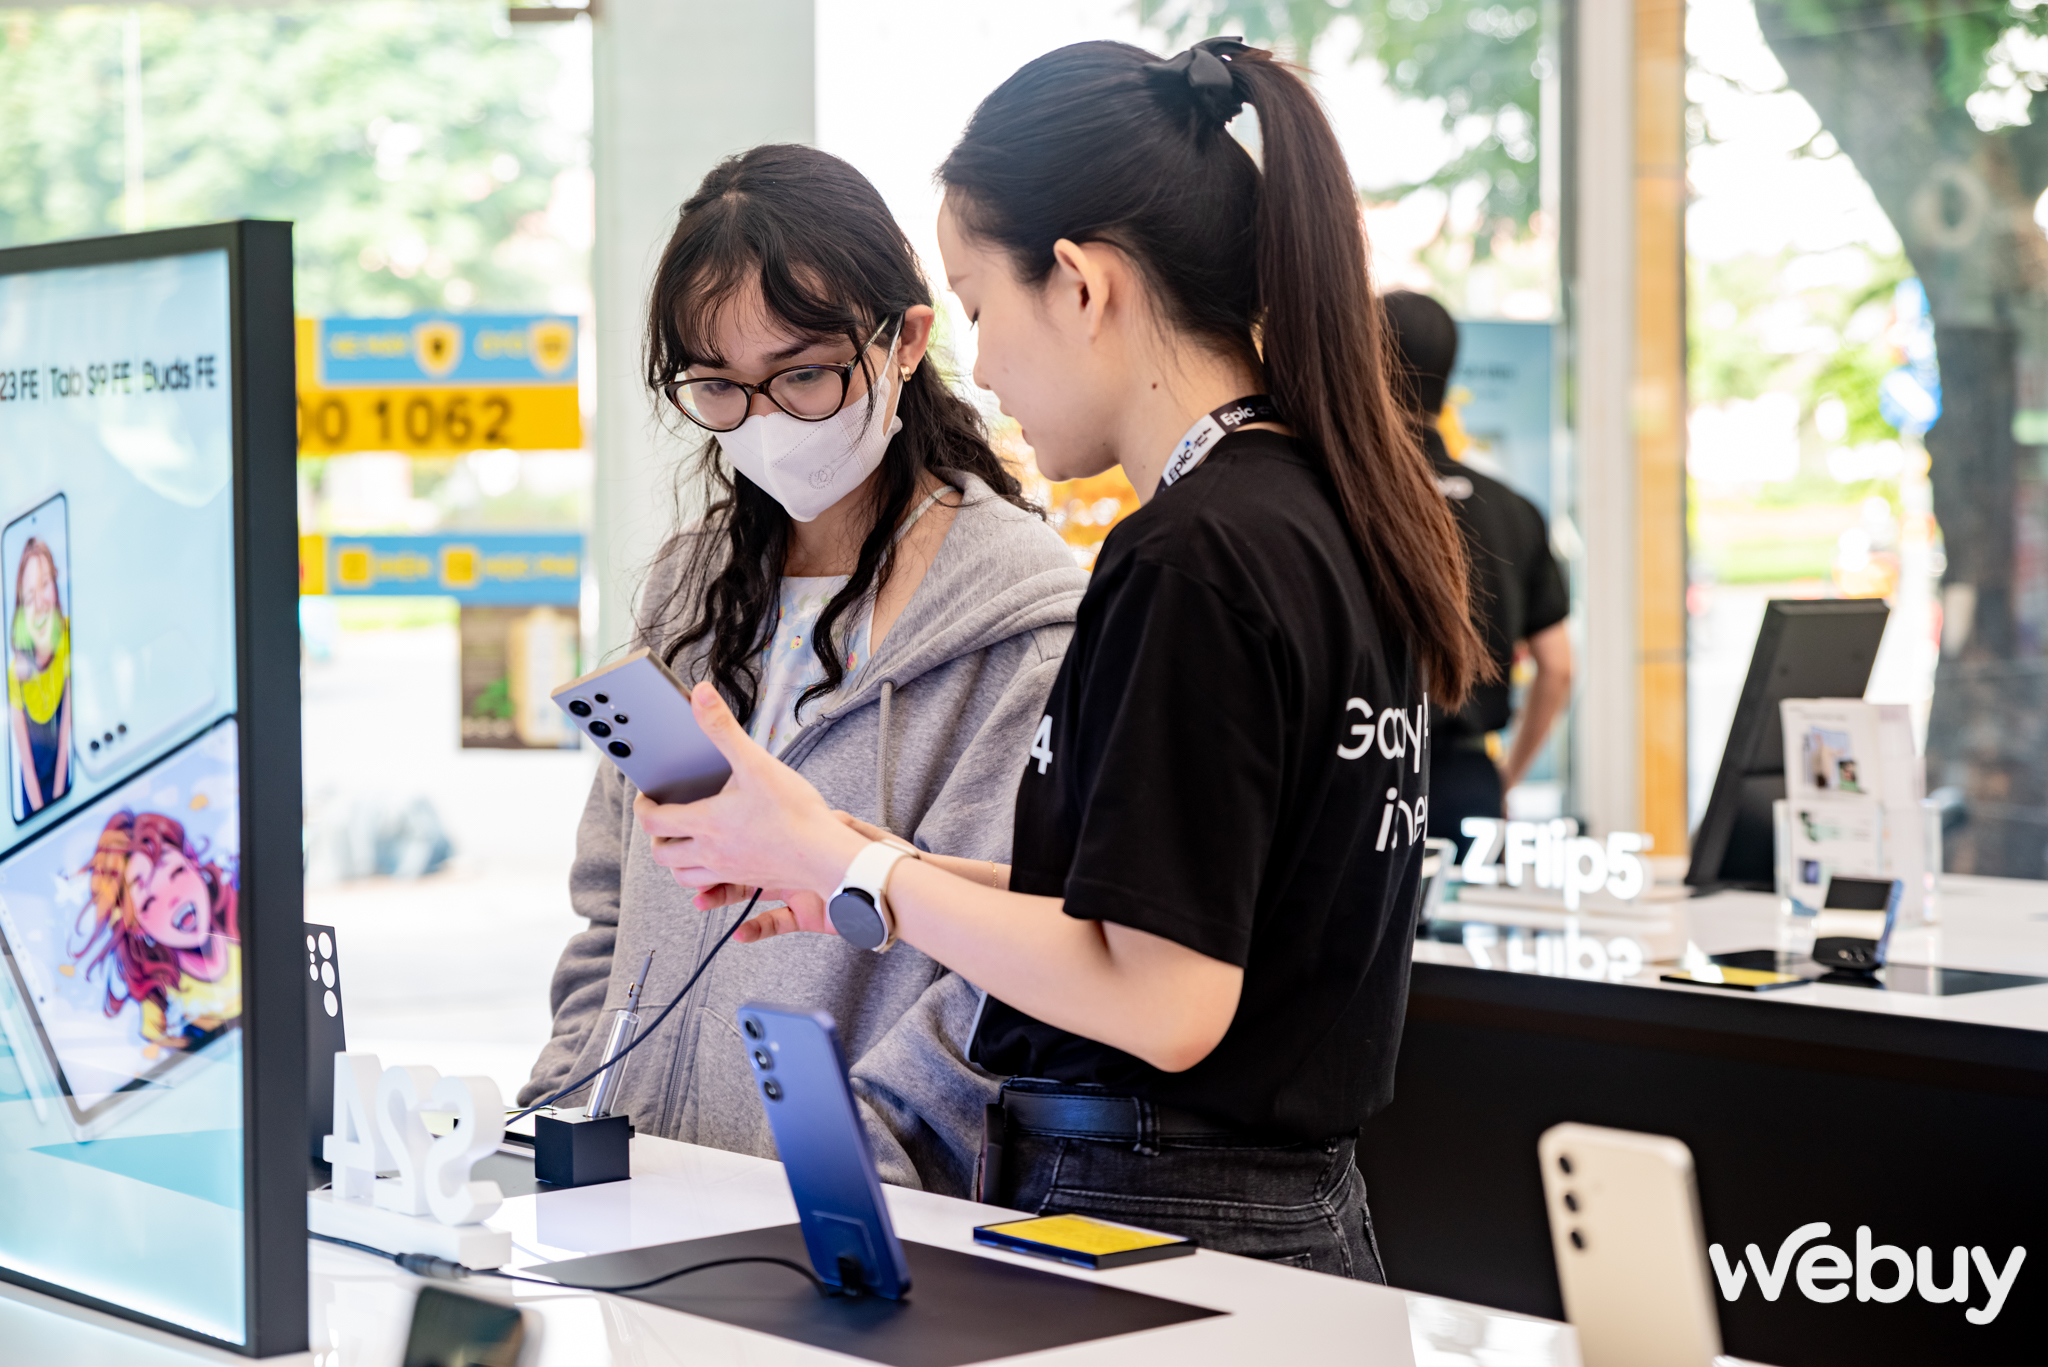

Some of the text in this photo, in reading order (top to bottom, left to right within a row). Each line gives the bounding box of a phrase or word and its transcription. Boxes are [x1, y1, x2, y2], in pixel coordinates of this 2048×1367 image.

[20, 369, 38, 399] FE
[50, 366, 83, 397] Tab
[87, 363, 107, 396] S9
[112, 361, 131, 393] FE
[142, 357, 190, 391] Buds
[197, 355, 215, 389] FE
[297, 394, 513, 448] 0 1062
[1220, 406, 1255, 426] Epic
[1168, 448, 1193, 481] Epic
[1461, 817, 1649, 911] Z Flip5
